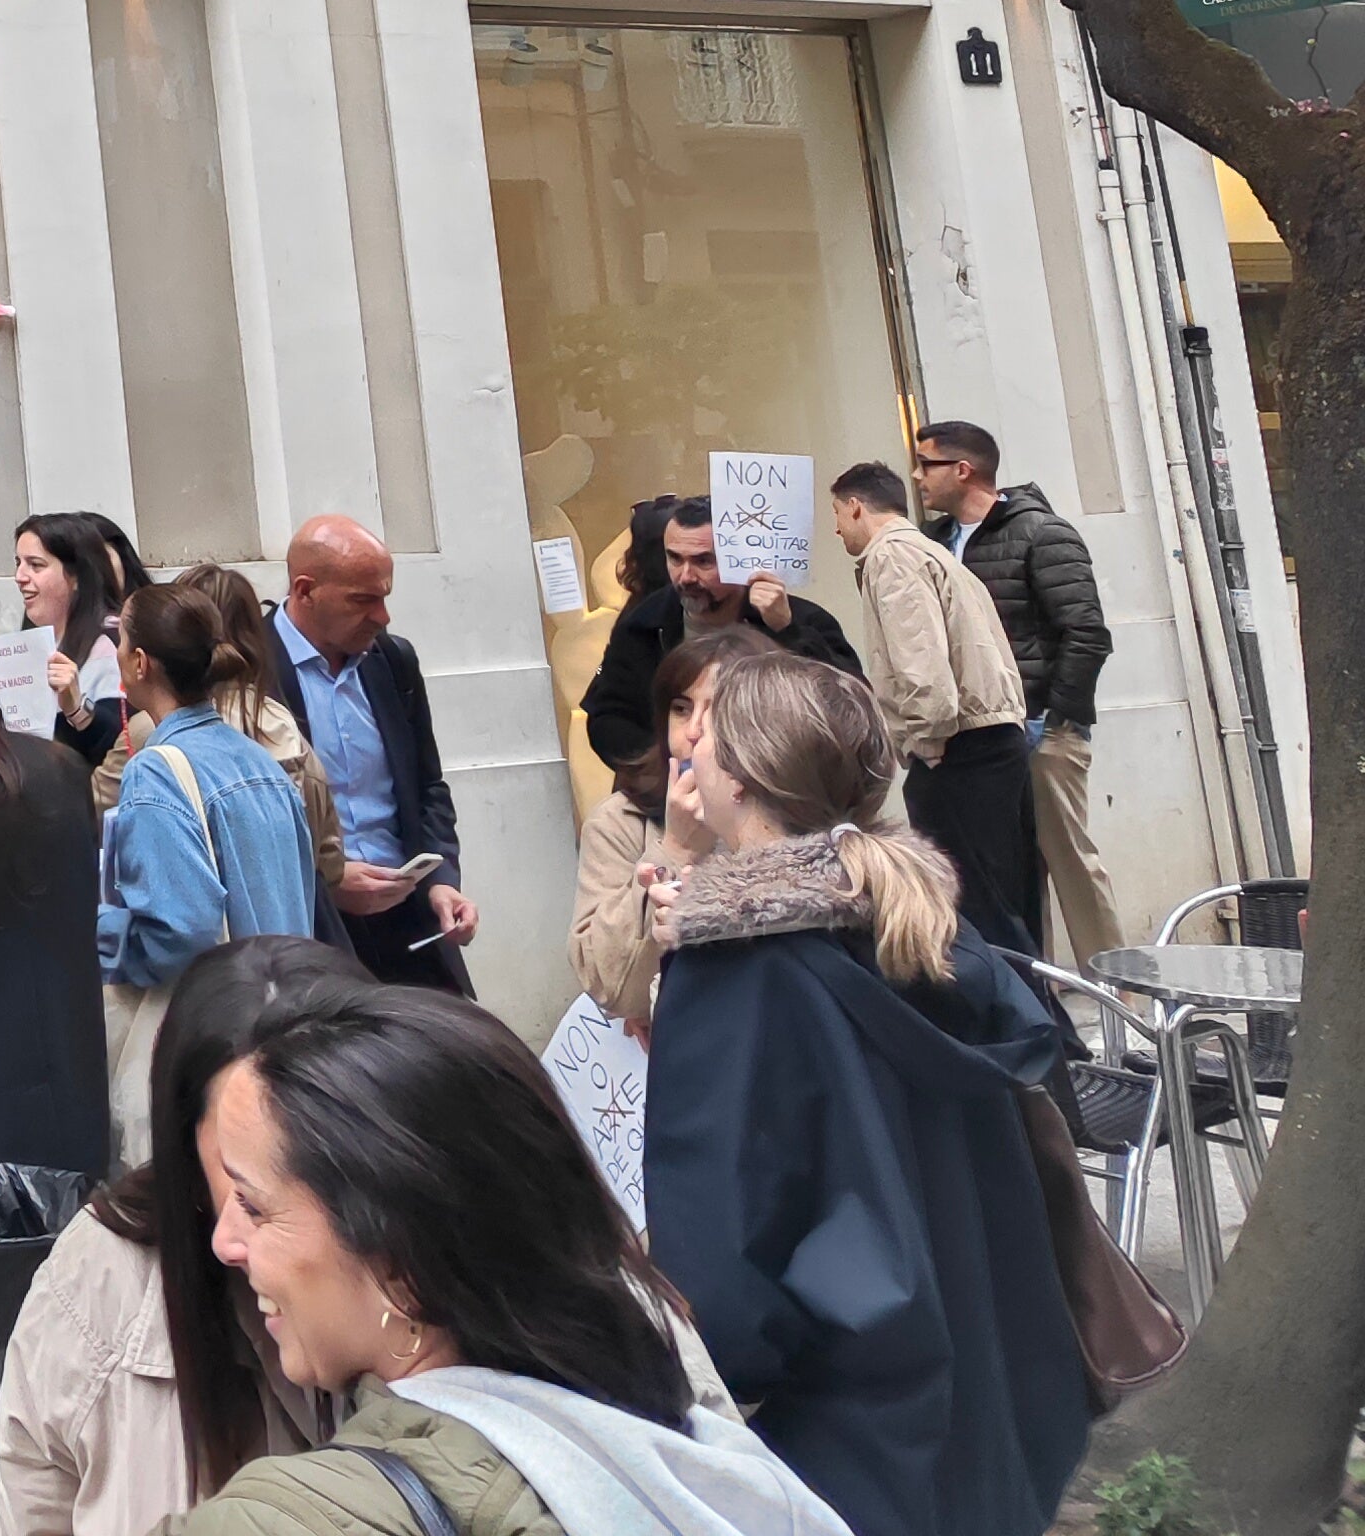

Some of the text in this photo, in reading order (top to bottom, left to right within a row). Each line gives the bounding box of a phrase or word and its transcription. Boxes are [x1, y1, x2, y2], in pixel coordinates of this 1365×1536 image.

[969, 52, 994, 76] 11
[725, 460, 788, 490] NON
[716, 532, 739, 547] DE
[554, 1013, 613, 1089] NON
[606, 1145, 629, 1184] DE
